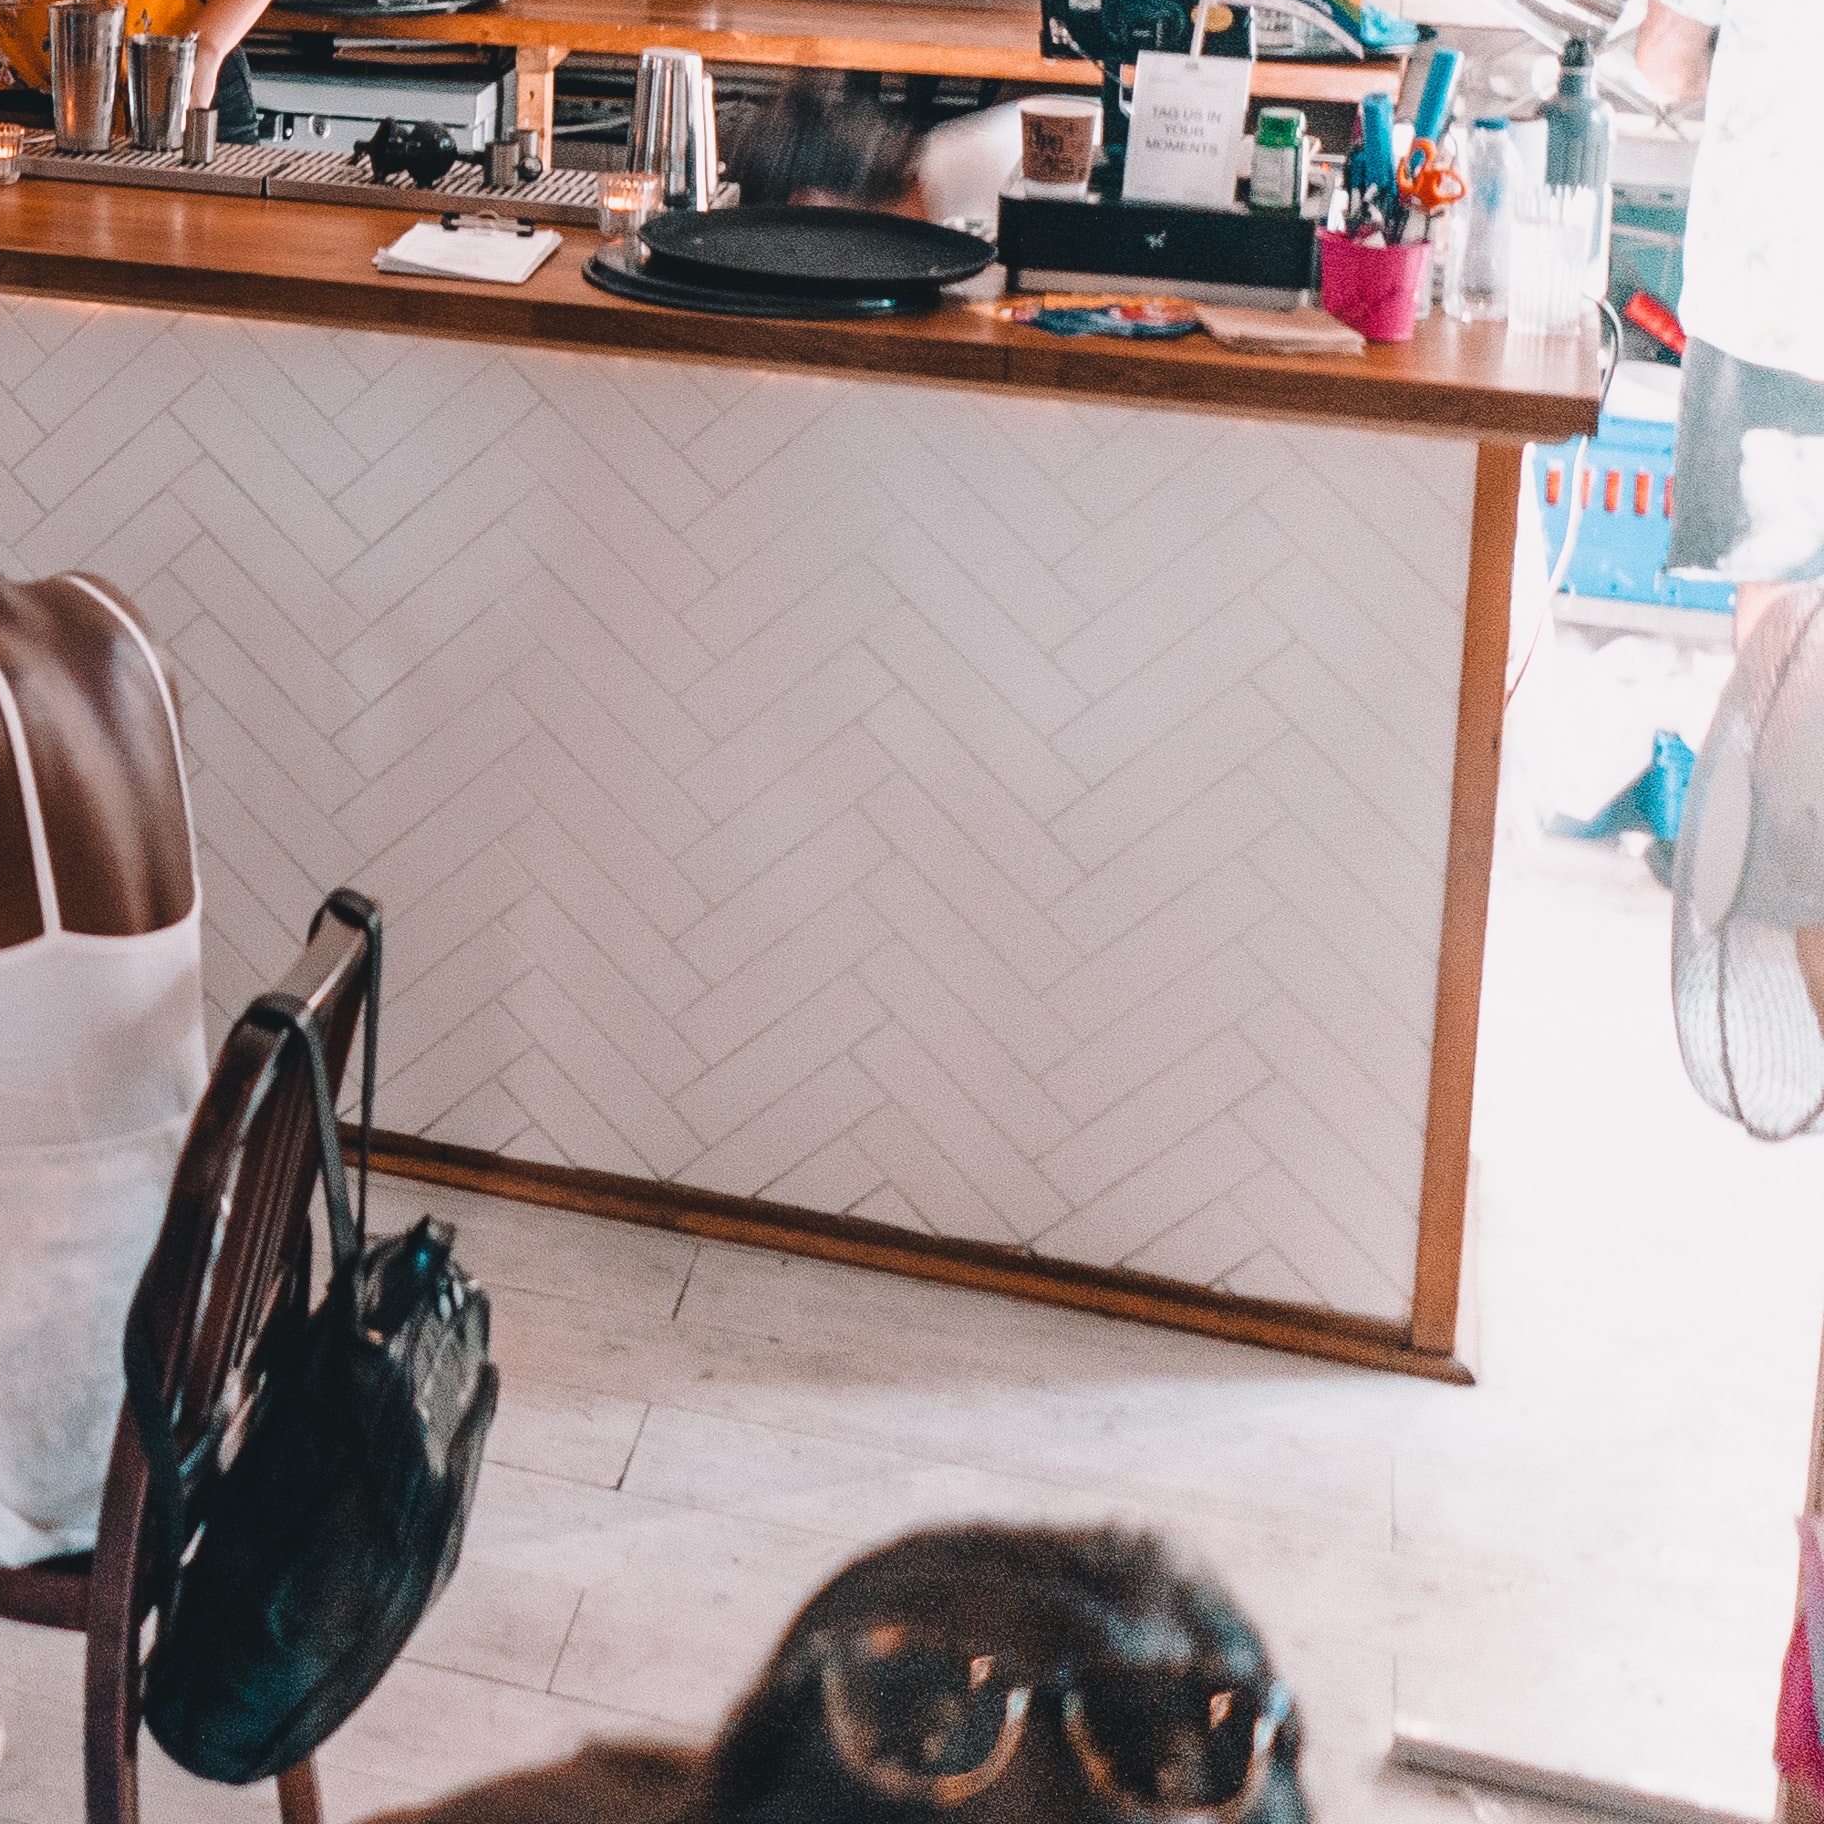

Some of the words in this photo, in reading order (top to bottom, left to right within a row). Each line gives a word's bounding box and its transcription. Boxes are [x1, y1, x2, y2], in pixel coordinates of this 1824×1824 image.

[1152, 105, 1179, 121] TAG
[1183, 107, 1203, 122] US
[1208, 109, 1222, 124] IN
[1164, 123, 1205, 137] YOUR
[1144, 136, 1219, 158] MOMENTS
